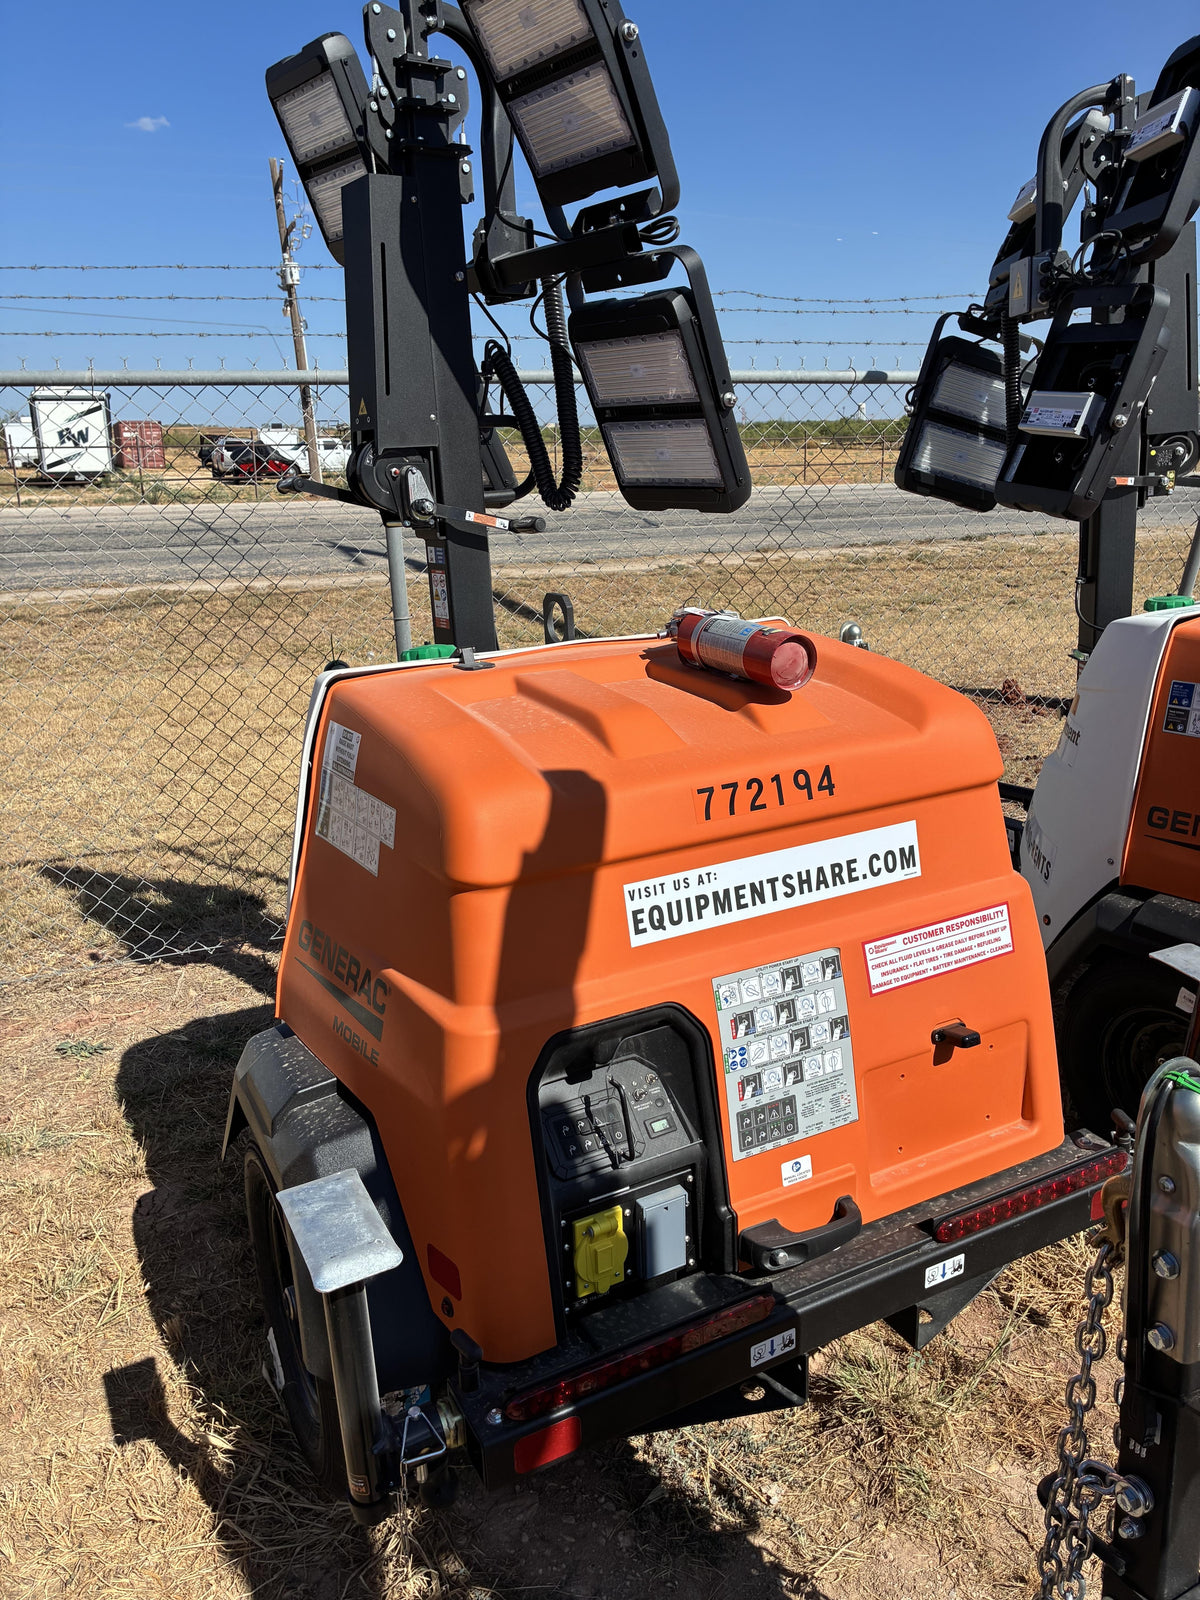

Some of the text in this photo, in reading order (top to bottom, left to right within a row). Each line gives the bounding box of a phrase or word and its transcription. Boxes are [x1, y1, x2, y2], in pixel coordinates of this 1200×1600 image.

[697, 764, 835, 821] 772194
[628, 873, 718, 901] VISIT US AT:
[632, 845, 916, 935] EQUIPMENTSHARE.COM
[871, 960, 888, 970] CHECK
[889, 957, 898, 965] ALL
[899, 953, 912, 962] FLUID
[913, 948, 931, 958] LEVELS
[936, 941, 954, 951] GREASE
[955, 937, 967, 946] DAILY
[968, 932, 985, 942] BEFORE
[986, 928, 1000, 937] START
[902, 909, 1004, 945] CUSTOMER RESPONSIBILITY
[298, 919, 388, 1015] GENERAC
[872, 979, 893, 990] DAMAGE
[900, 968, 928, 981] EQUIPMENT
[933, 960, 953, 971] BATTERY
[954, 951, 986, 965] MAINTENANCE
[990, 943, 1011, 953] CLEANING
[881, 964, 909, 977] INSURANCE
[913, 959, 925, 968] FLAT
[926, 956, 939, 965] TIRES
[954, 945, 973, 956] DAMAGE
[977, 936, 1001, 948] REFUELING
[332, 1015, 380, 1067] MOBILE
